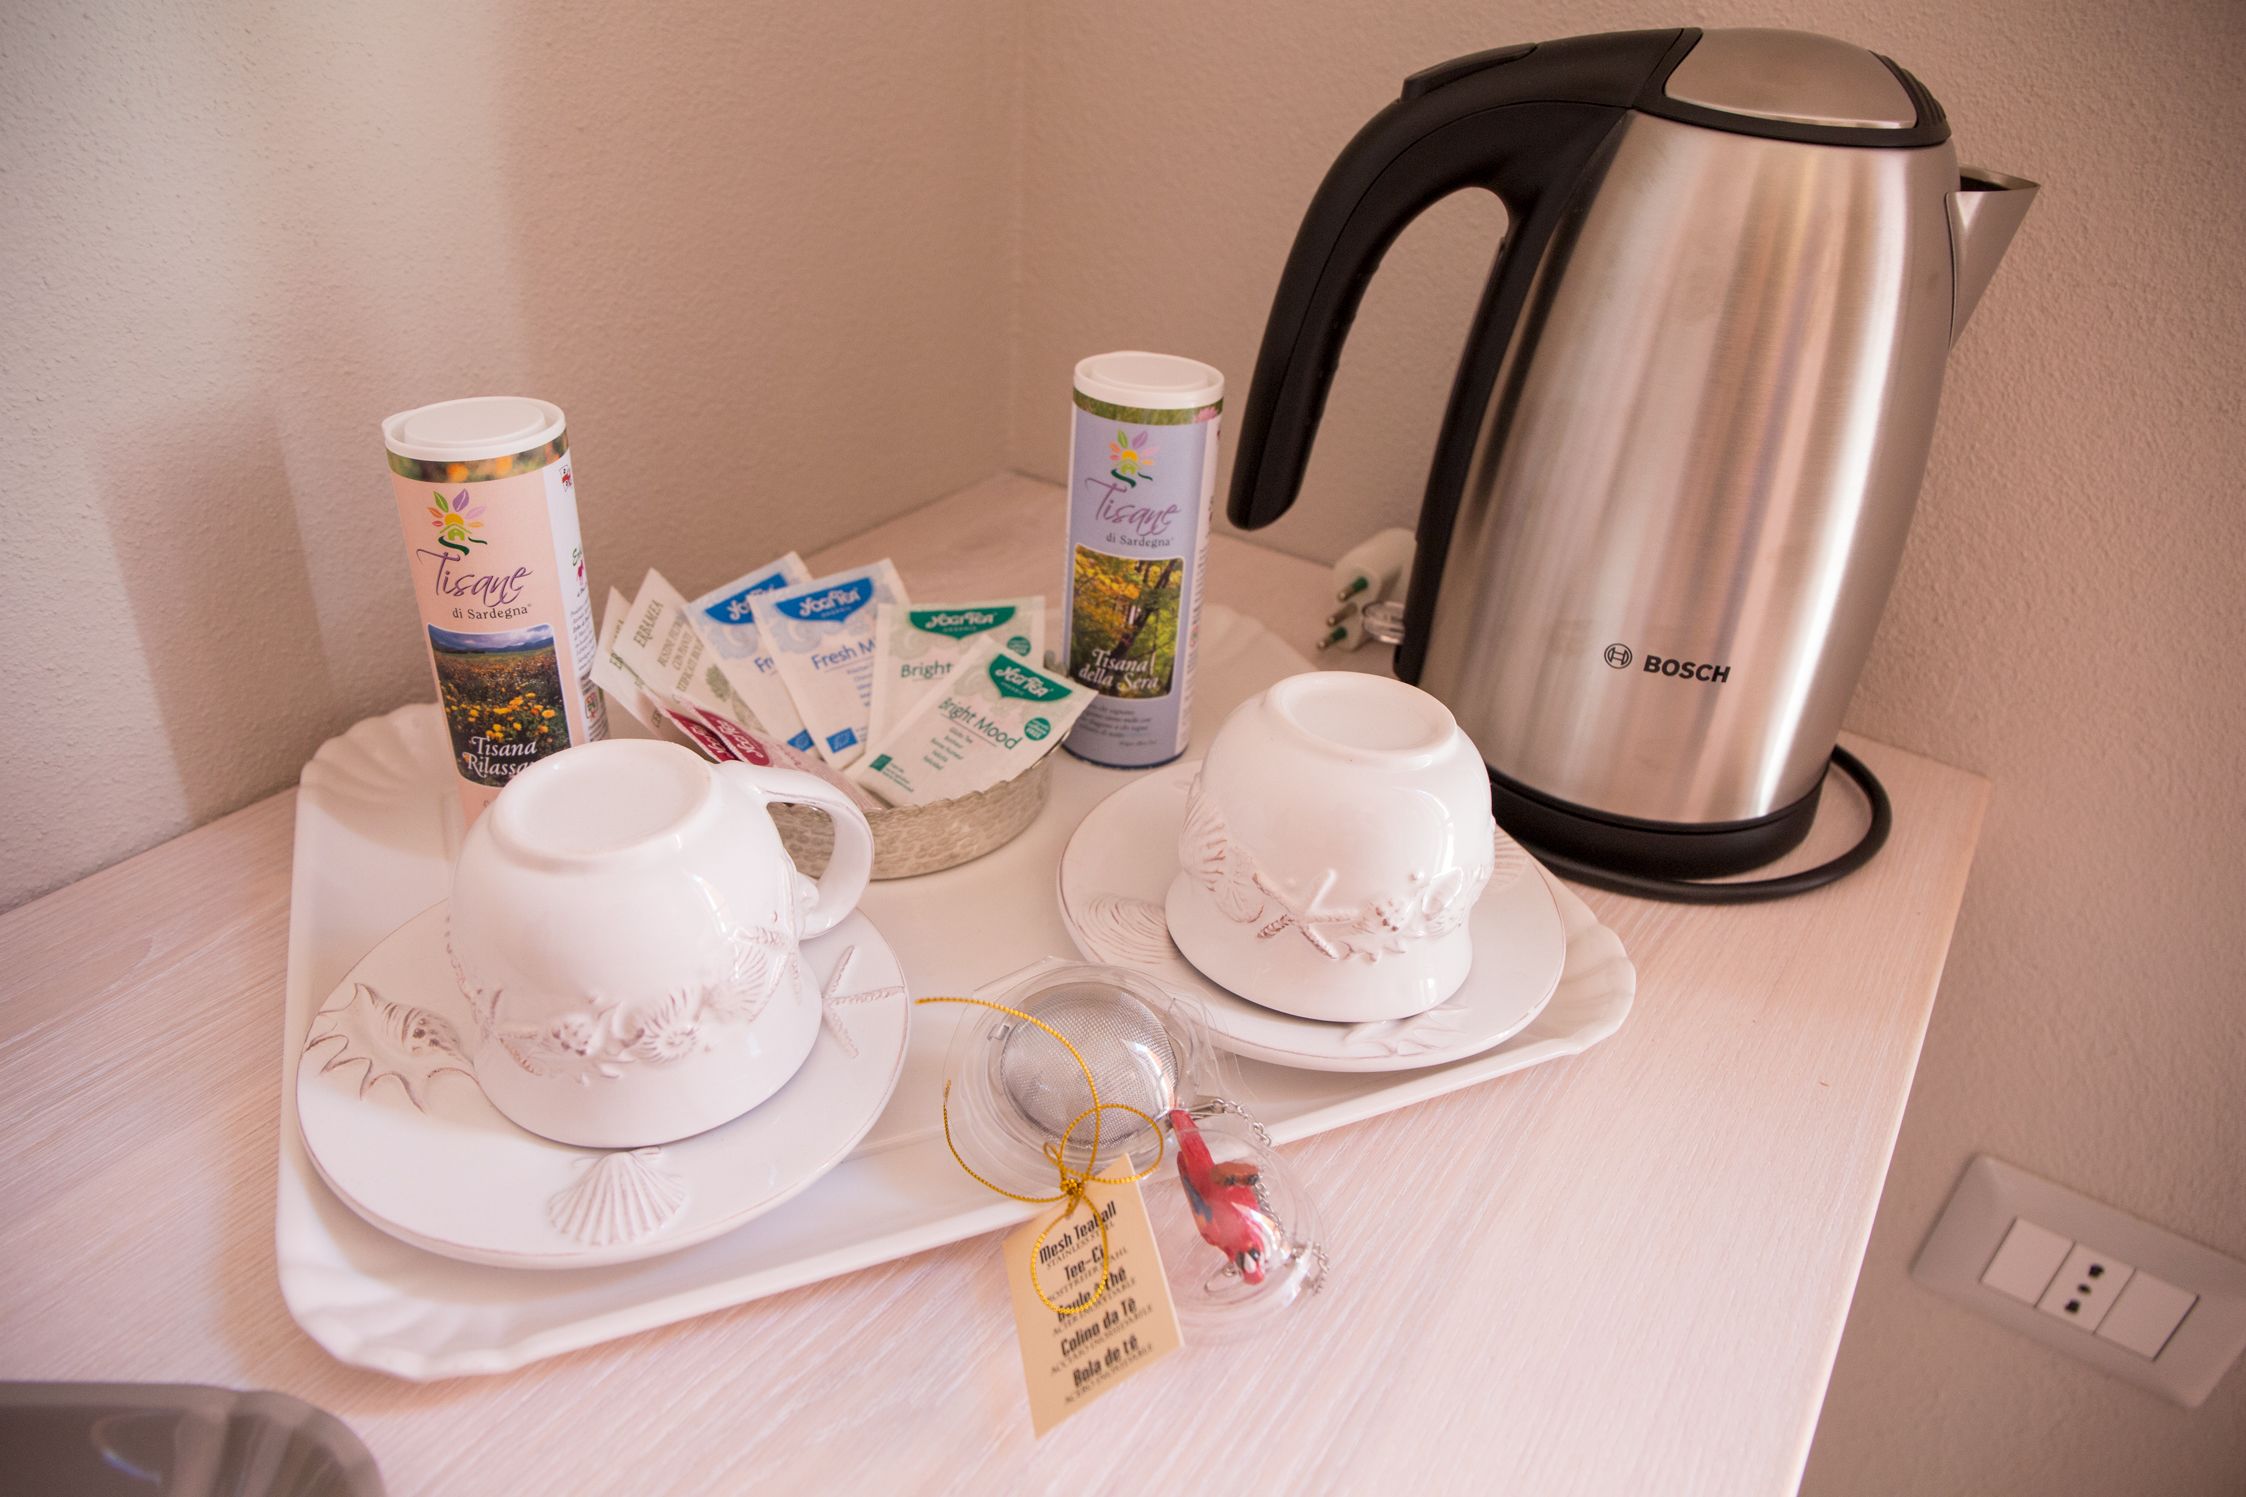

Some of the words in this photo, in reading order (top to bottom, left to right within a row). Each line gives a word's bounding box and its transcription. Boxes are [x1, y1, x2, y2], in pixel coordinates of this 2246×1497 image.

[1084, 477, 1181, 536] Tisane
[1106, 533, 1116, 543] di
[1120, 535, 1170, 548] Sardegna
[416, 548, 533, 607] Tisane
[452, 608, 463, 619] di
[468, 606, 528, 620] Sardegna
[811, 644, 858, 670] Fresh
[1092, 648, 1149, 672] Tisana
[1643, 654, 1731, 683] BOSCH
[901, 662, 954, 681] Bright
[1078, 664, 1114, 687] della
[938, 698, 977, 725] Bright
[978, 717, 1023, 750] Mood
[471, 736, 538, 756] Tisana
[462, 752, 536, 778] Rilassa
[1038, 1233, 1073, 1265] Mesh
[1060, 1322, 1100, 1357] Colino
[1104, 1310, 1120, 1330] da
[1072, 1359, 1102, 1388] Bola
[1105, 1346, 1121, 1368] de
